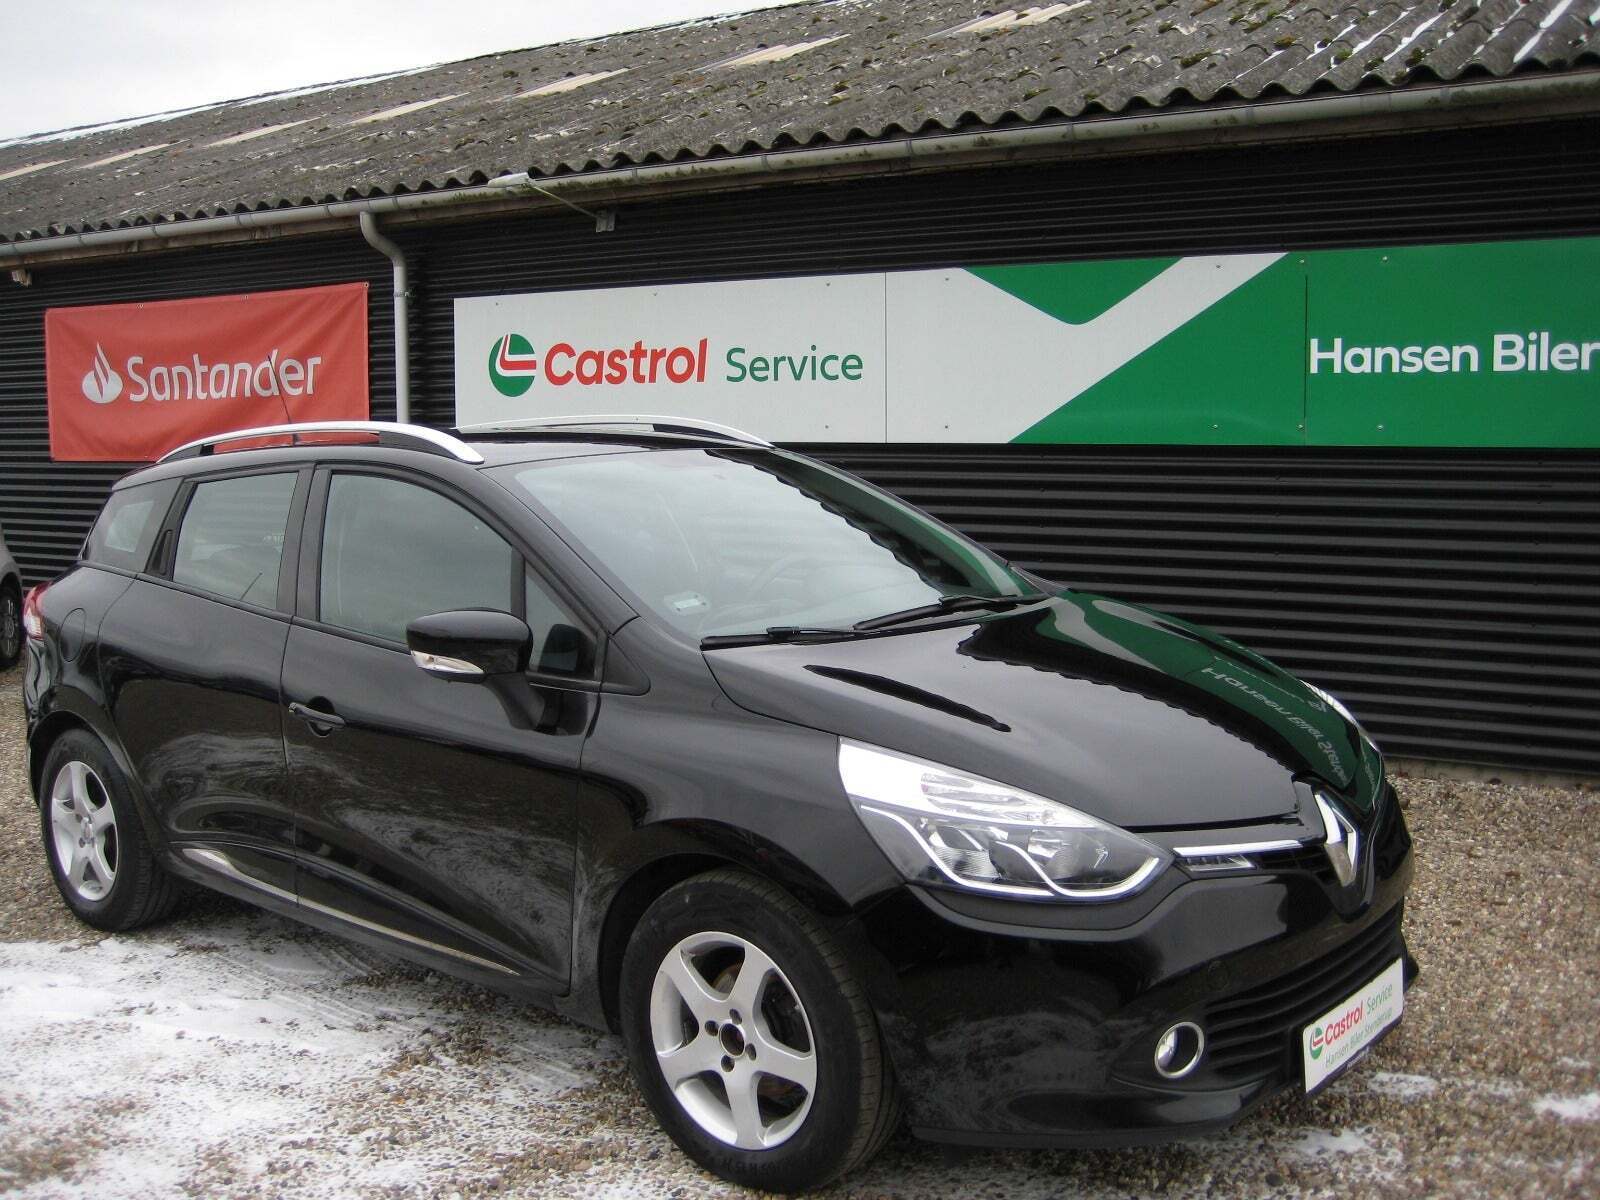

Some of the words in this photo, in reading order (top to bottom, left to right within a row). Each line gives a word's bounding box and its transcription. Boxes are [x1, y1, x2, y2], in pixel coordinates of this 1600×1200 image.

[126, 349, 322, 402] Santander
[544, 337, 708, 386] Castrol
[726, 344, 864, 383] Service
[1309, 338, 1479, 374] Hansen
[1492, 331, 1600, 372] Biler
[1324, 1000, 1364, 1045] Castrol
[1366, 983, 1393, 1015] Service
